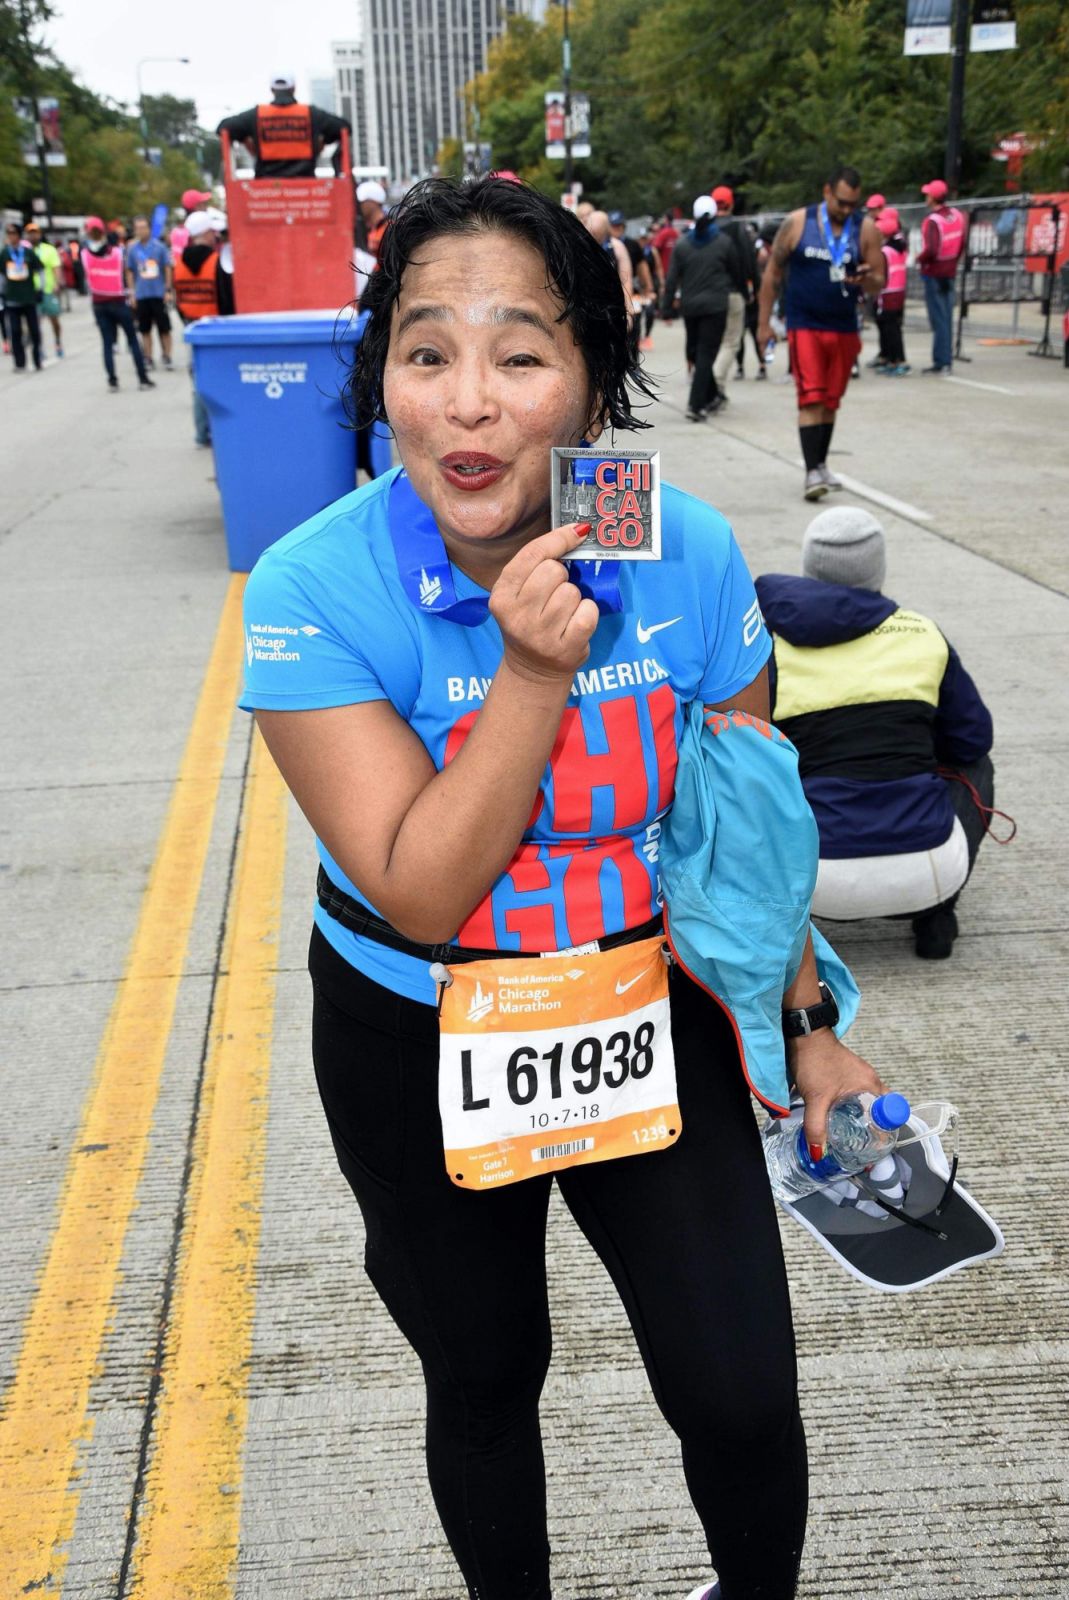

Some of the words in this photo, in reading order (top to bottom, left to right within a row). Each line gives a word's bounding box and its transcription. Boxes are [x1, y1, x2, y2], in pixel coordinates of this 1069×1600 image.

[241, 371, 306, 383] RECYCLE
[595, 461, 650, 491] CHI
[595, 490, 643, 519] CA
[596, 519, 644, 548] GO
[267, 625, 298, 636] America
[252, 635, 286, 652] Chicago
[254, 648, 300, 661] Marathon
[447, 676, 493, 702] BAN
[498, 975, 520, 985] Bank
[520, 975, 529, 984] of
[530, 974, 564, 984] America
[498, 988, 550, 1000] Chicago
[498, 999, 562, 1013] Marathon
[461, 1049, 490, 1112] L
[506, 1021, 655, 1106] 61938
[632, 1124, 668, 1145] 1239
[483, 1160, 503, 1171] Gate
[479, 1169, 514, 1184] Harrison
